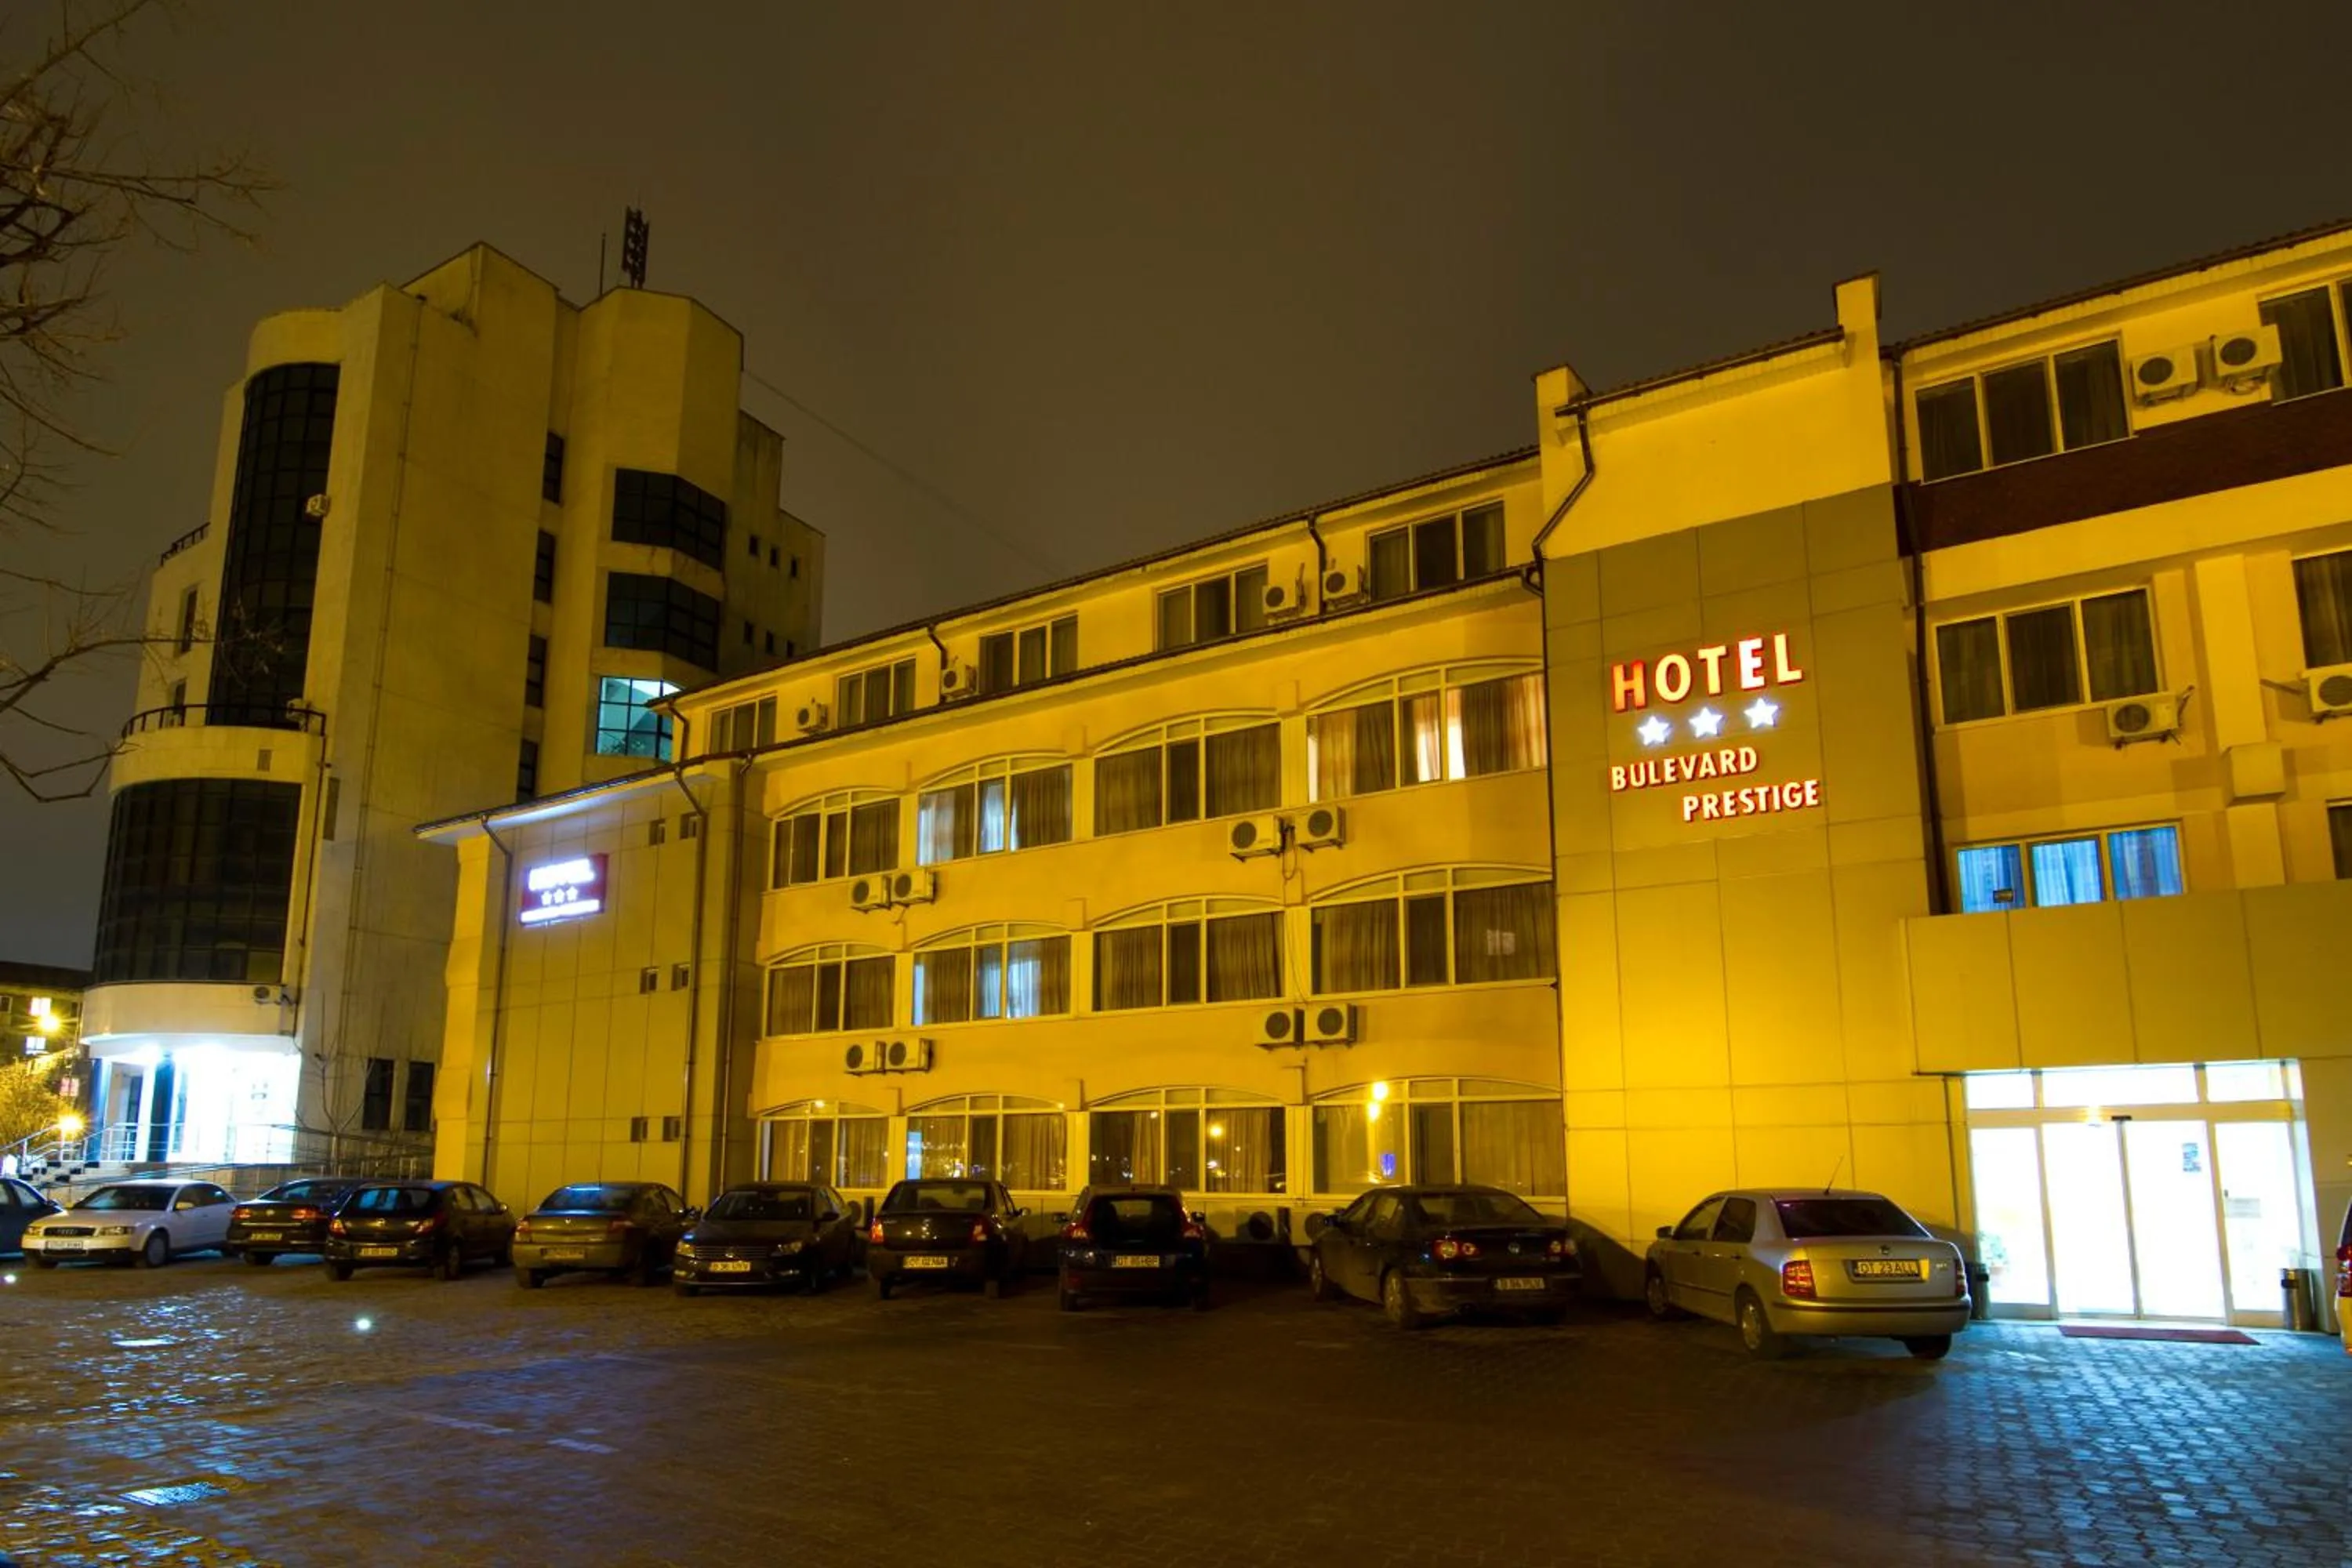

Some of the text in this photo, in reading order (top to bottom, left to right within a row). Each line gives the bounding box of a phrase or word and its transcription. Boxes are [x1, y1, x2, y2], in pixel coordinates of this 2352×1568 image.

[1612, 633, 1803, 710] HOTEL
[1611, 746, 1758, 792] BULEVARD
[1682, 779, 1820, 822] PRESTIGE
